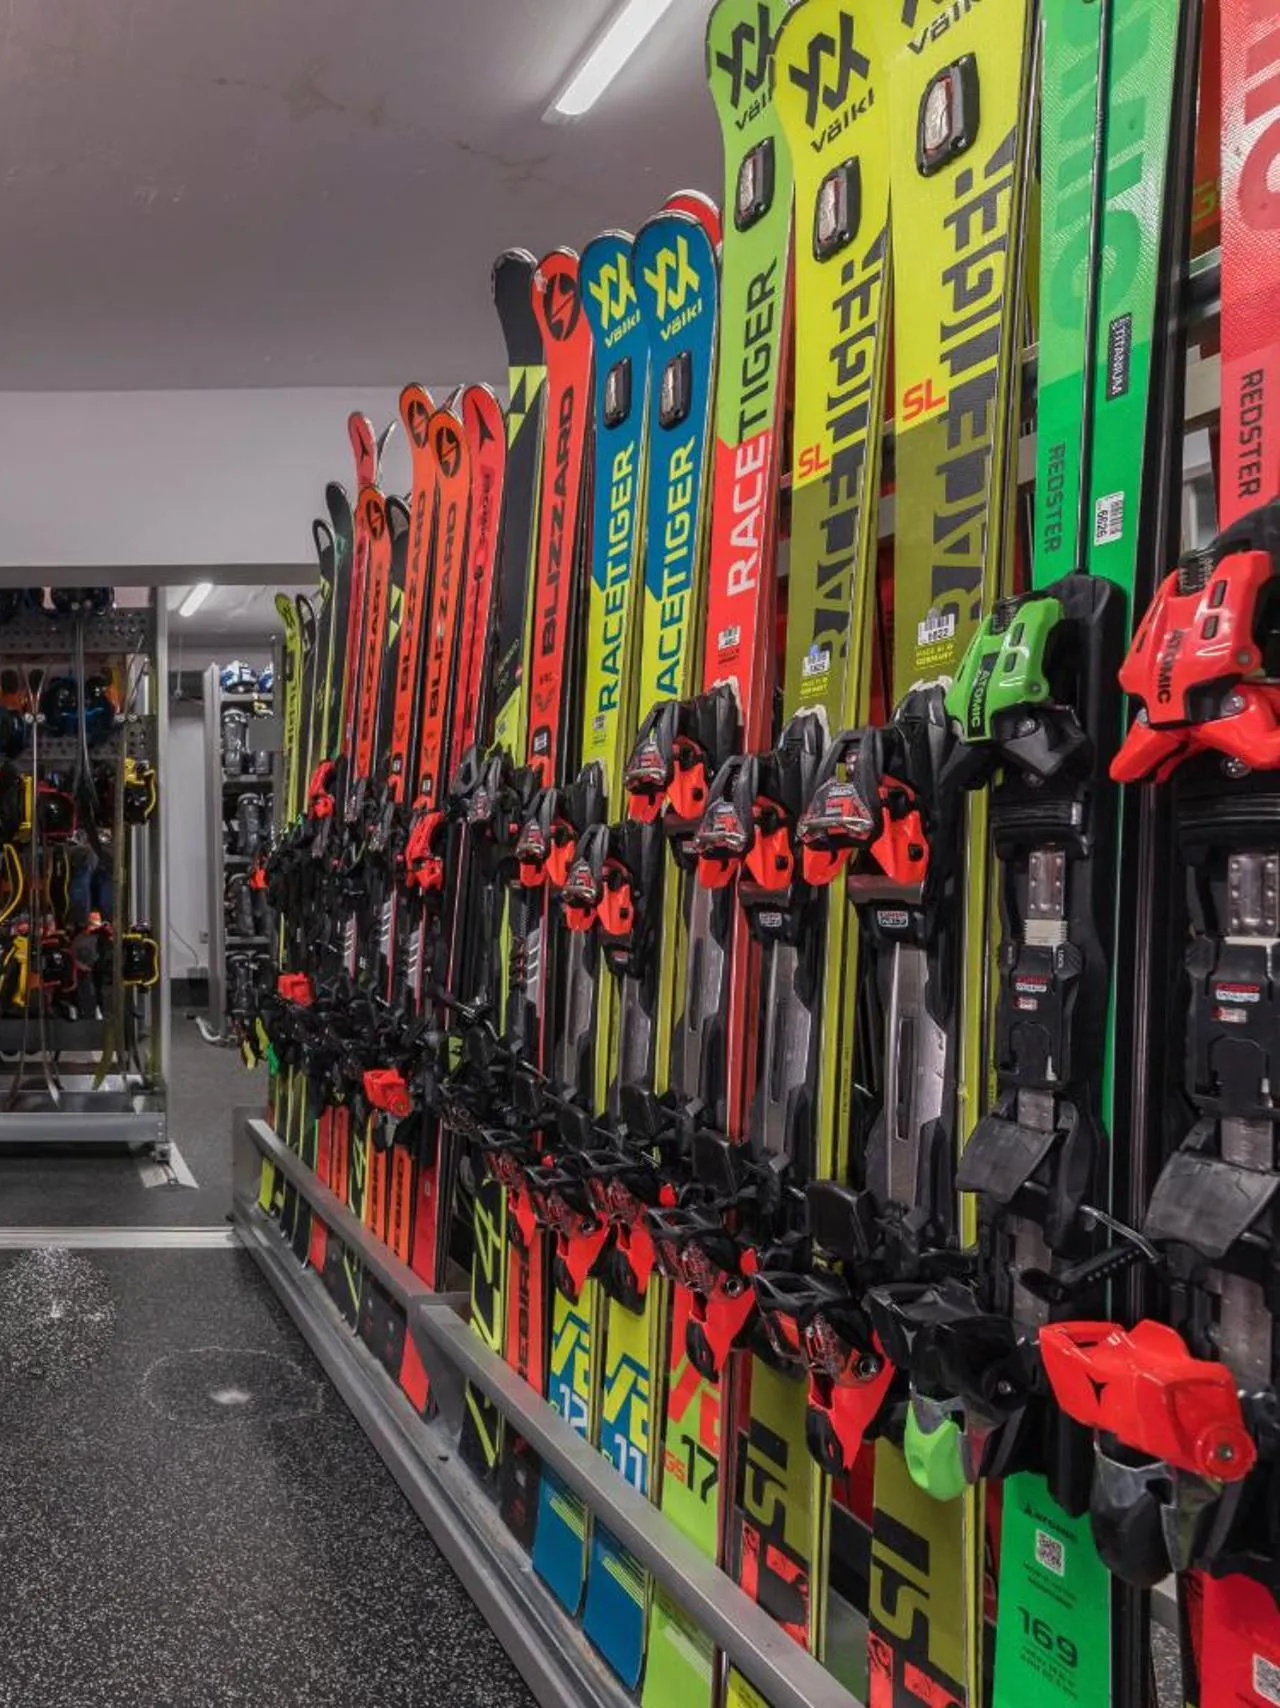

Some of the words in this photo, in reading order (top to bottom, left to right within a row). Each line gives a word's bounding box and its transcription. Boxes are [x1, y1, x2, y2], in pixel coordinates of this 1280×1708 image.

[902, 378, 947, 424] SL
[1238, 369, 1265, 500] REDSTER
[797, 443, 830, 480] SL
[1044, 442, 1067, 555] REDSTER
[542, 388, 574, 658] BLIZZARD
[598, 440, 634, 713] RACETIGER
[656, 435, 696, 696] ACETIGER
[429, 502, 457, 717] BLIZZARD
[971, 668, 990, 728] ATOMIC
[1157, 629, 1184, 704] ATOMIC
[1018, 1606, 1079, 1668] 169
